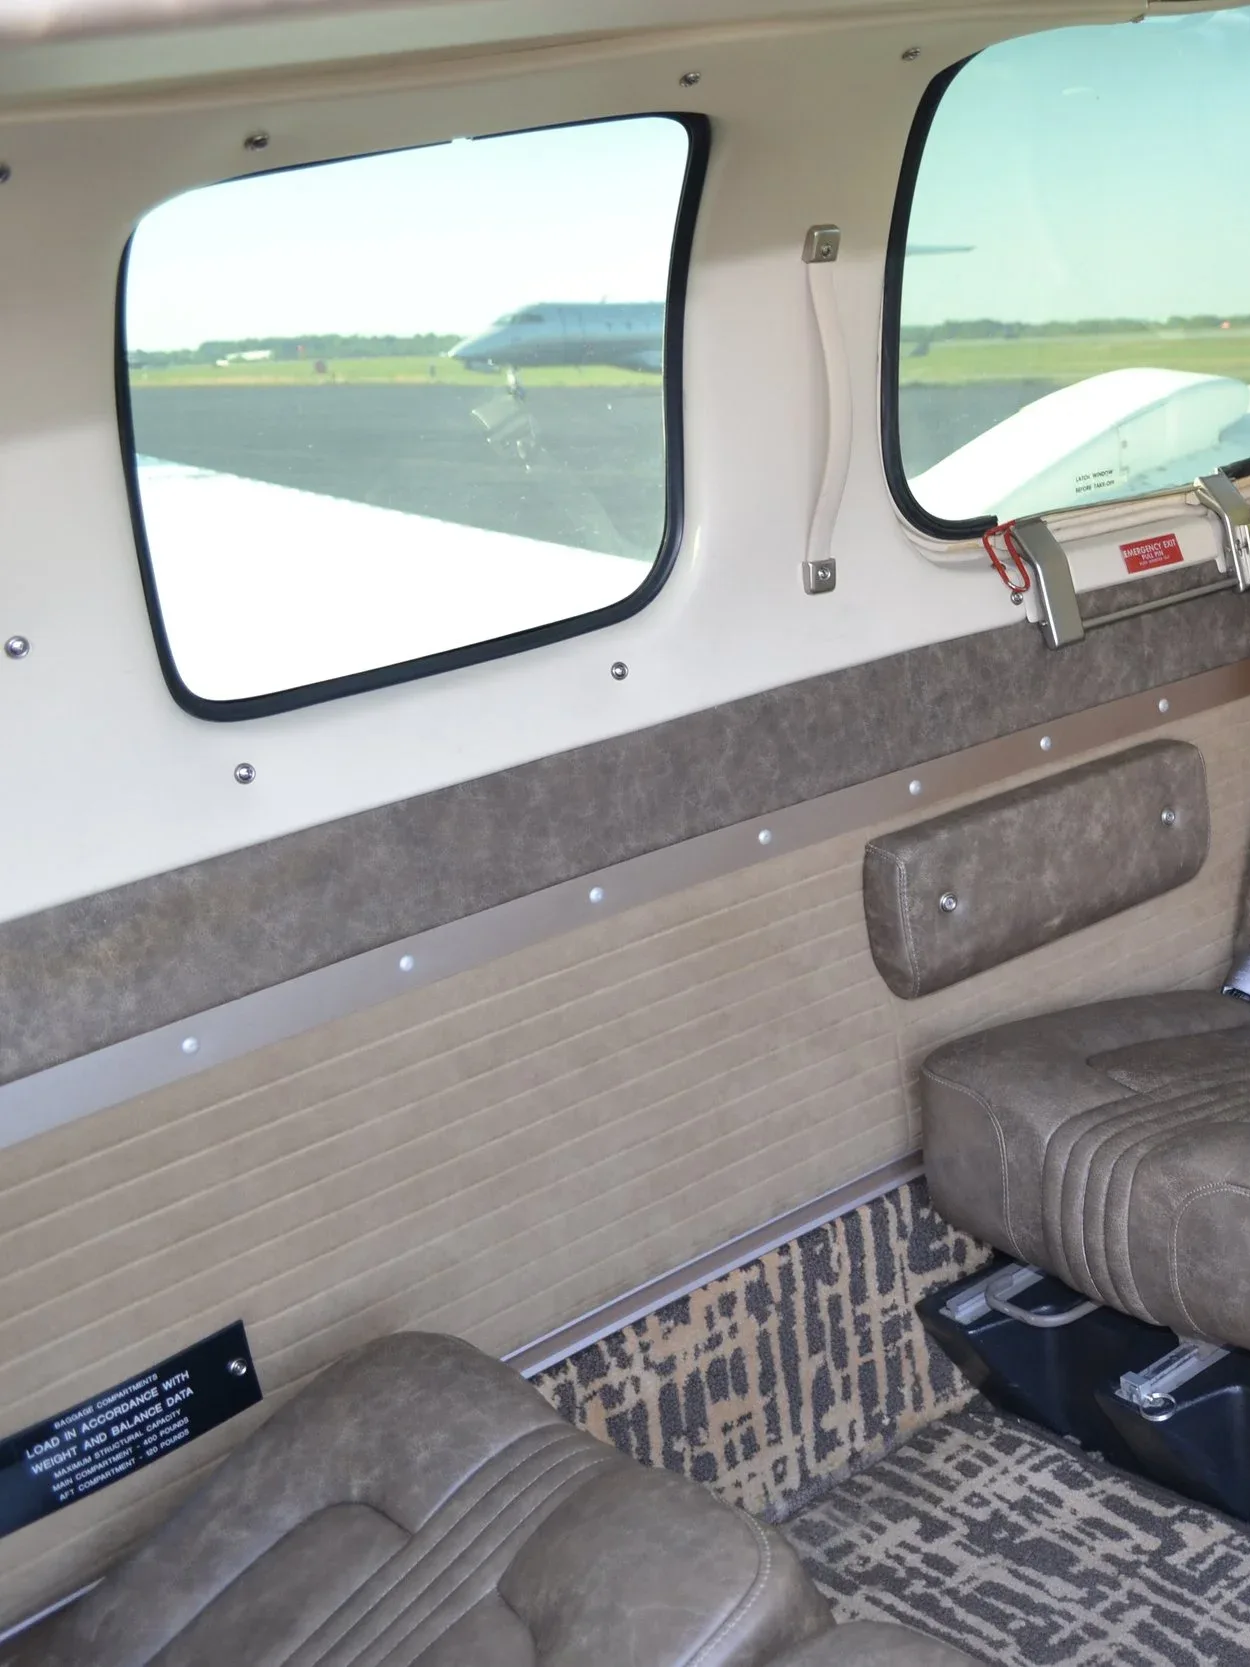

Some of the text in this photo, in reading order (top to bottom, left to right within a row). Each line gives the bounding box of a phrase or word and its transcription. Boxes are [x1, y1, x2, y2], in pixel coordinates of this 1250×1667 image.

[1075, 484, 1092, 493] BEFORE
[1092, 469, 1113, 478] WINDOW
[1123, 539, 1176, 558] EMERGENCY EXIT
[26, 1370, 189, 1459] LOAD IN ACCORDANCE WITH
[31, 1387, 194, 1475] WEIGHT AND BALANCE DATA
[54, 1374, 158, 1429] BAGGAGE COMPARTMENTS
[52, 1478, 73, 1492] MAIN
[76, 1447, 133, 1480] COMPARTMENT
[144, 1434, 157, 1445] 400
[160, 1417, 189, 1436] POUNDS
[54, 1409, 181, 1479] MAXIMUM STRUCTURAL CAPACITY
[60, 1489, 74, 1501] AFT
[78, 1458, 135, 1492] COMPARTMENT
[146, 1447, 158, 1457] 120
[160, 1429, 189, 1449] POUNDS
